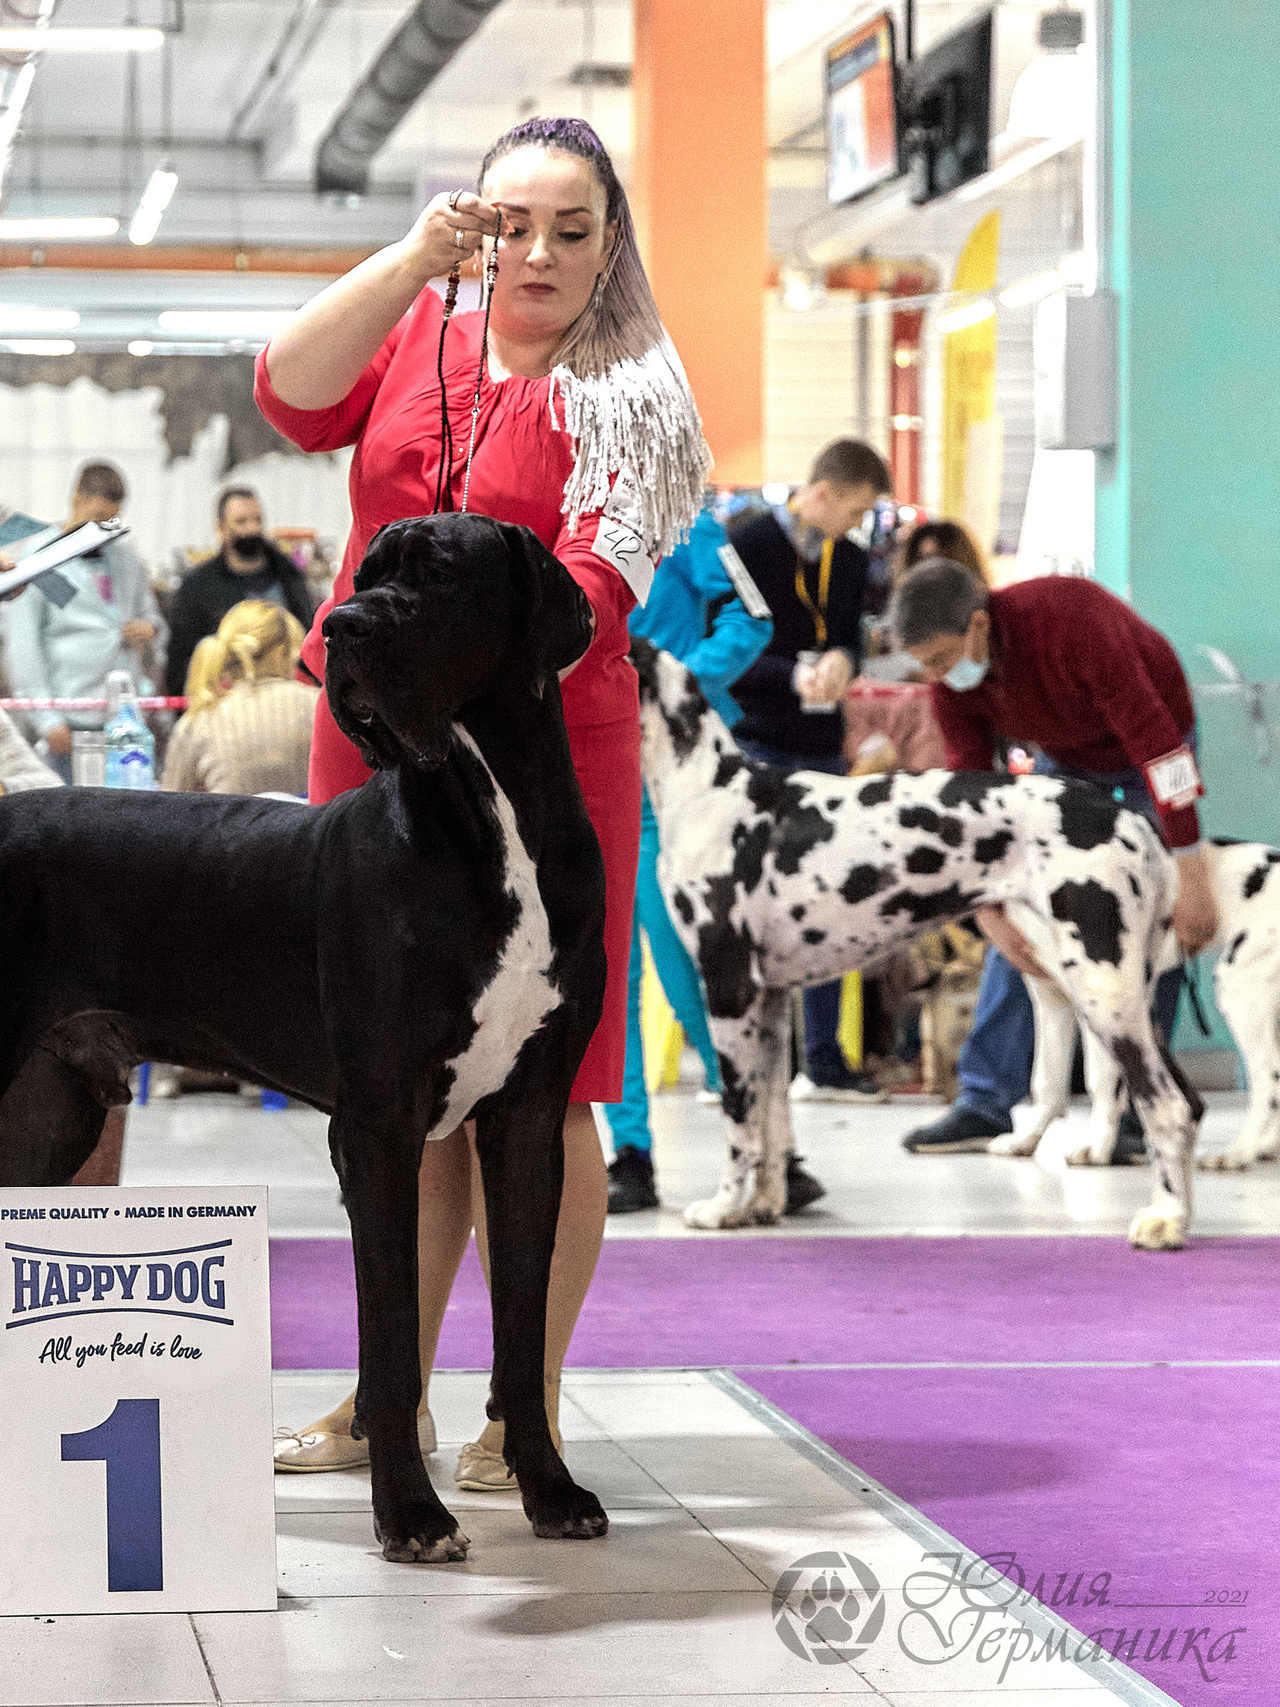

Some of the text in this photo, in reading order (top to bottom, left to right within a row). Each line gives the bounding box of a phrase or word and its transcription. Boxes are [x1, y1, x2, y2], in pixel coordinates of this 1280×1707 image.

[604, 529, 641, 566] 42
[49, 1208, 110, 1220] QUALITY
[124, 1207, 166, 1219] MADE
[168, 1207, 183, 1218] IN
[186, 1206, 257, 1218] GERMANY
[11, 1255, 226, 1314] HAPPY DOG
[38, 1333, 203, 1368] All you feed is love
[60, 1398, 163, 1593] 1
